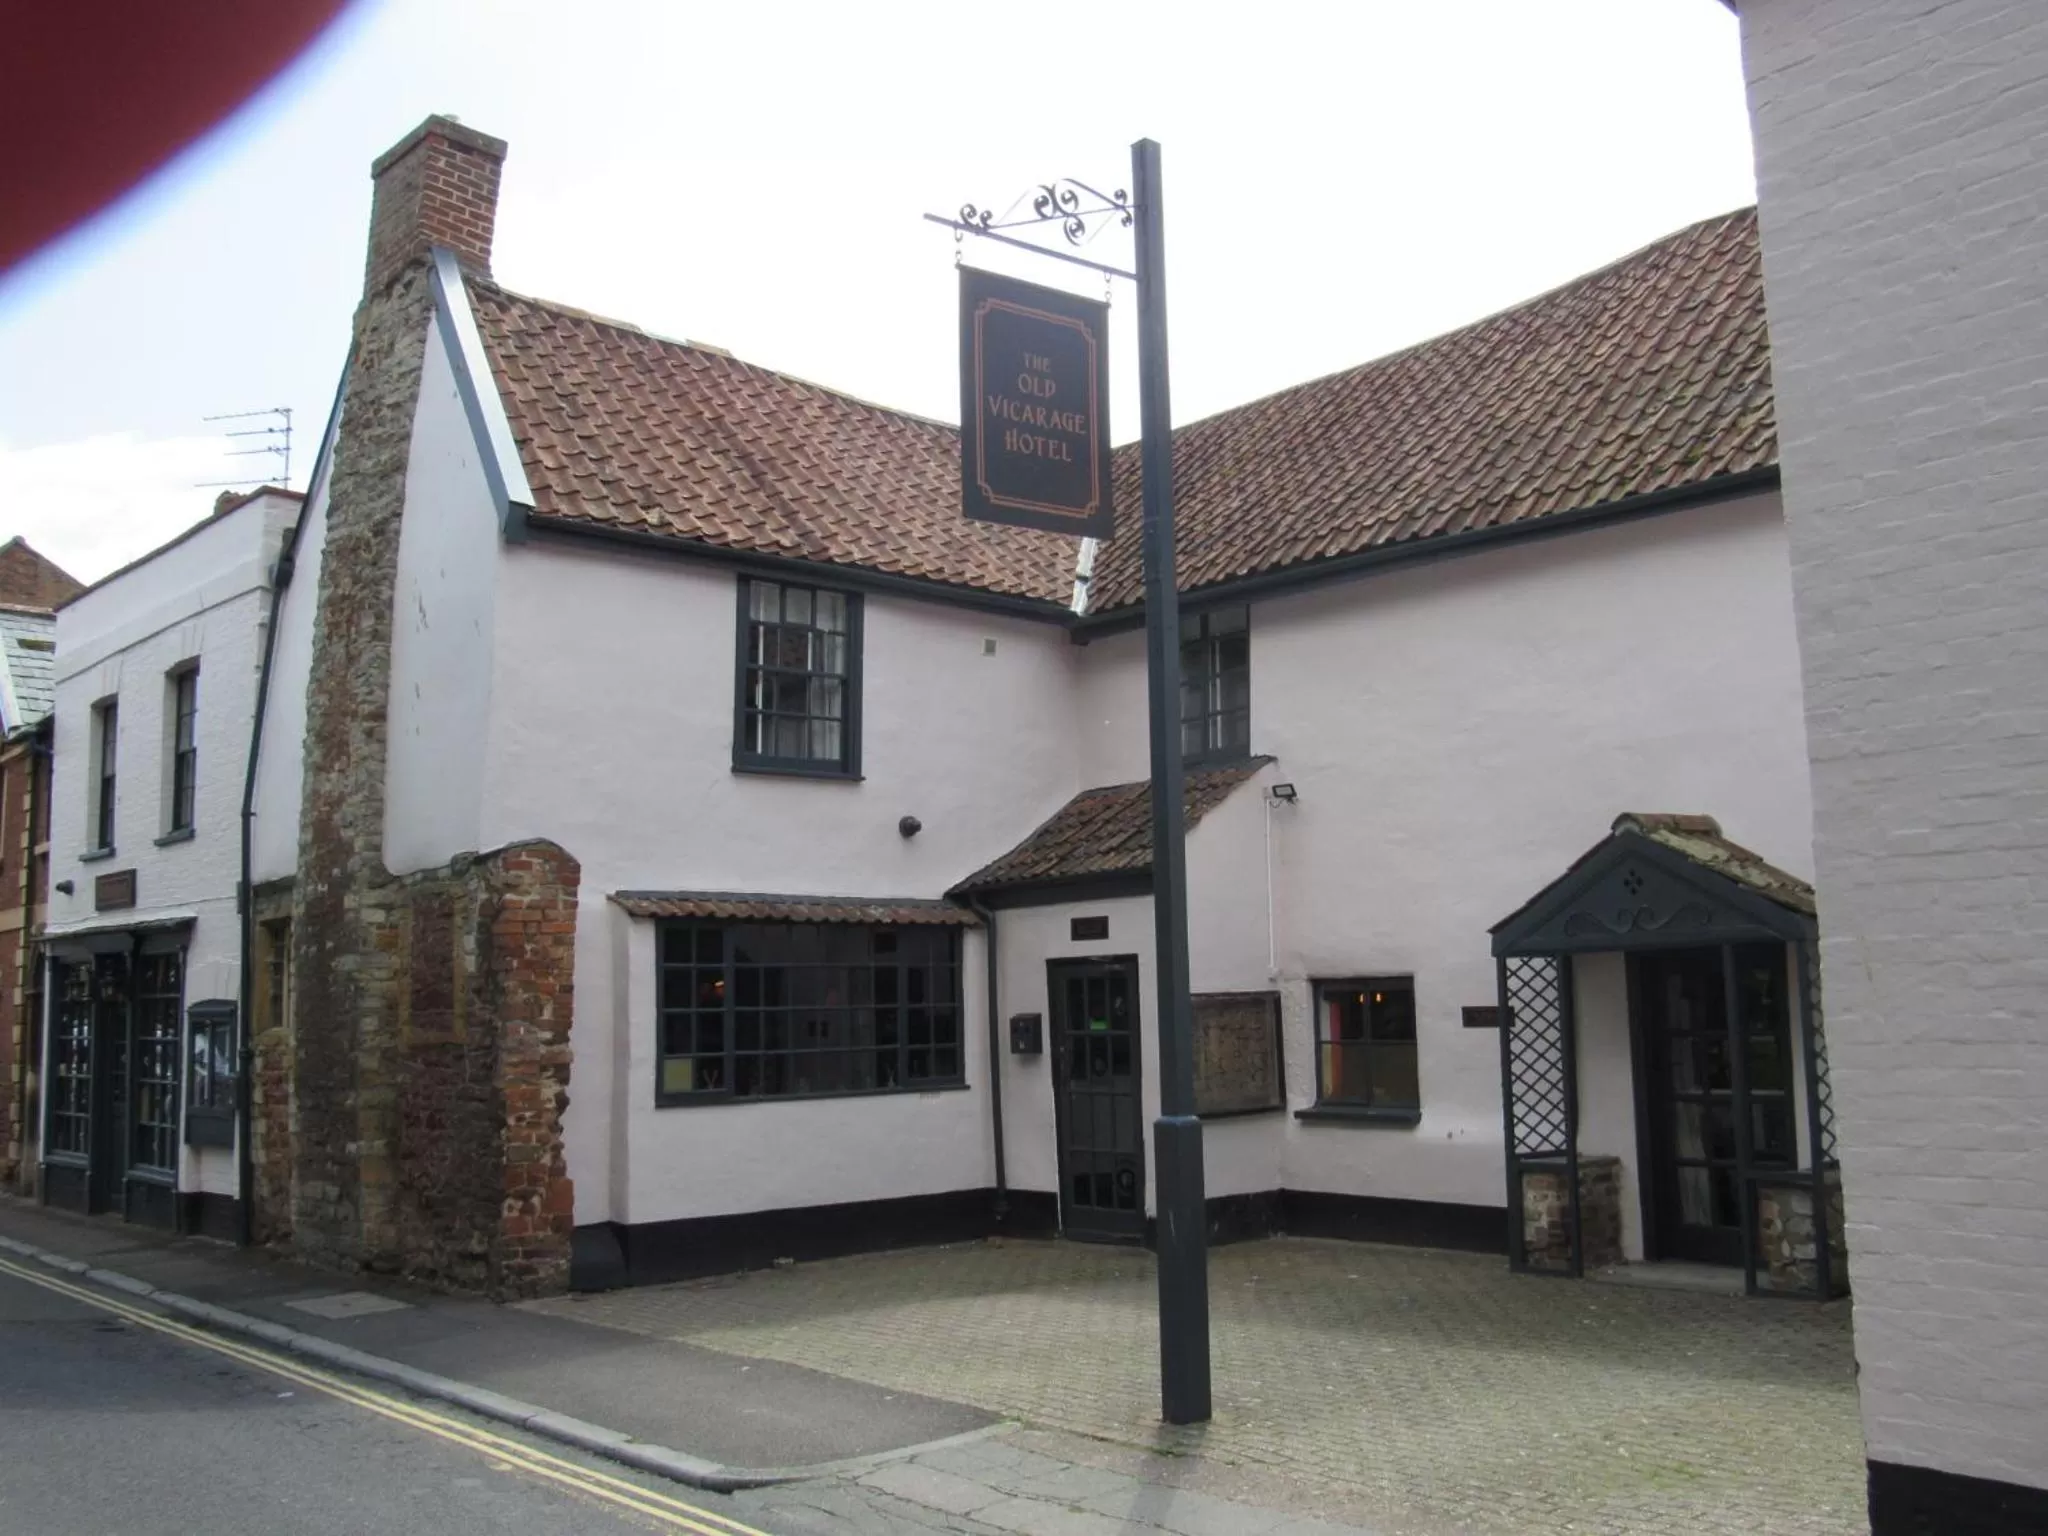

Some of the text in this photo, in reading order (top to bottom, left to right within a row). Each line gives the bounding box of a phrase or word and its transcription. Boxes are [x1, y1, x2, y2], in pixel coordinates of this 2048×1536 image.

[1024, 353, 1051, 372] THE
[1018, 373, 1056, 398] OLD
[988, 395, 1087, 434] VICARAGE
[1005, 428, 1072, 462] HOTEL
